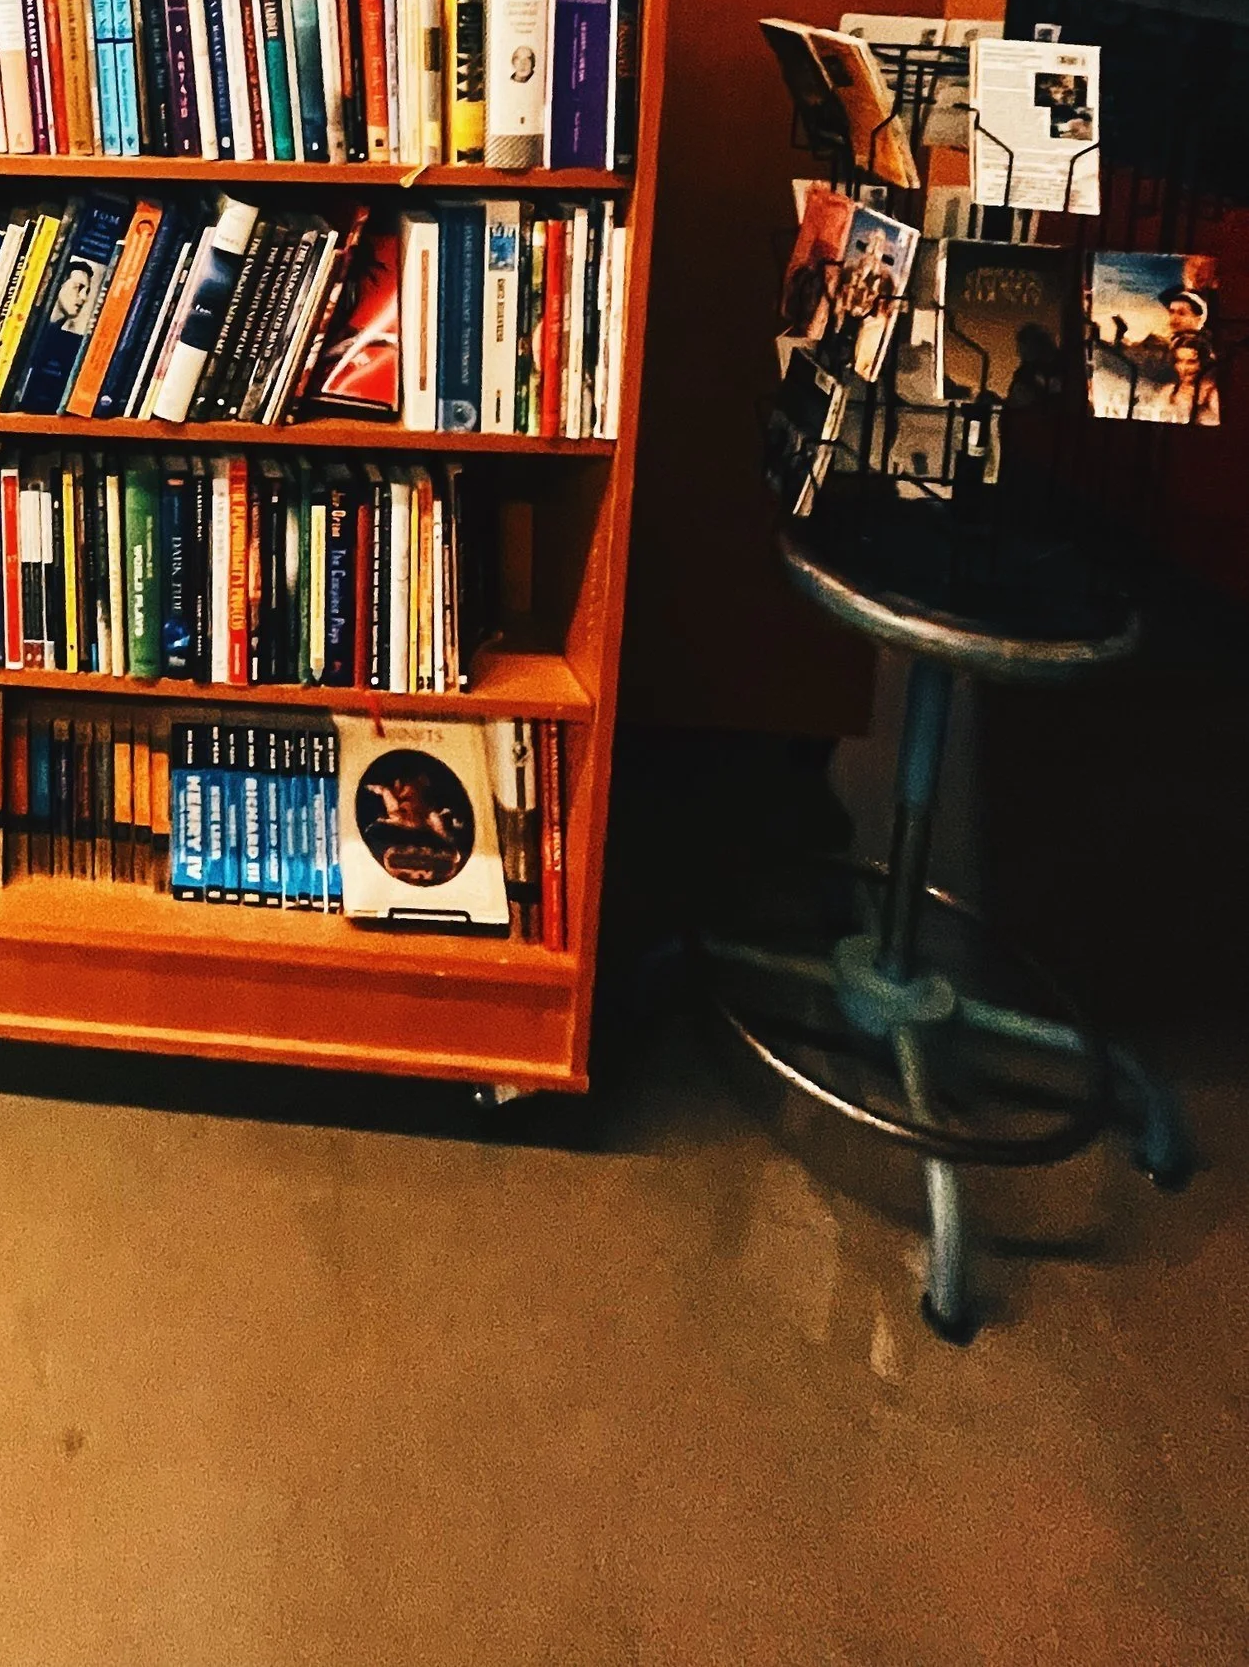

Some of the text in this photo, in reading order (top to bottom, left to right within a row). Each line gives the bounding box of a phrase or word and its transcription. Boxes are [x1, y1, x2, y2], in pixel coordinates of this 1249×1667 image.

[133, 544, 144, 637] WORLD PLAYS
[171, 536, 183, 576] DARK
[332, 549, 346, 566] The
[187, 776, 202, 880] HENRY IV
[245, 778, 259, 859] RICHARD
